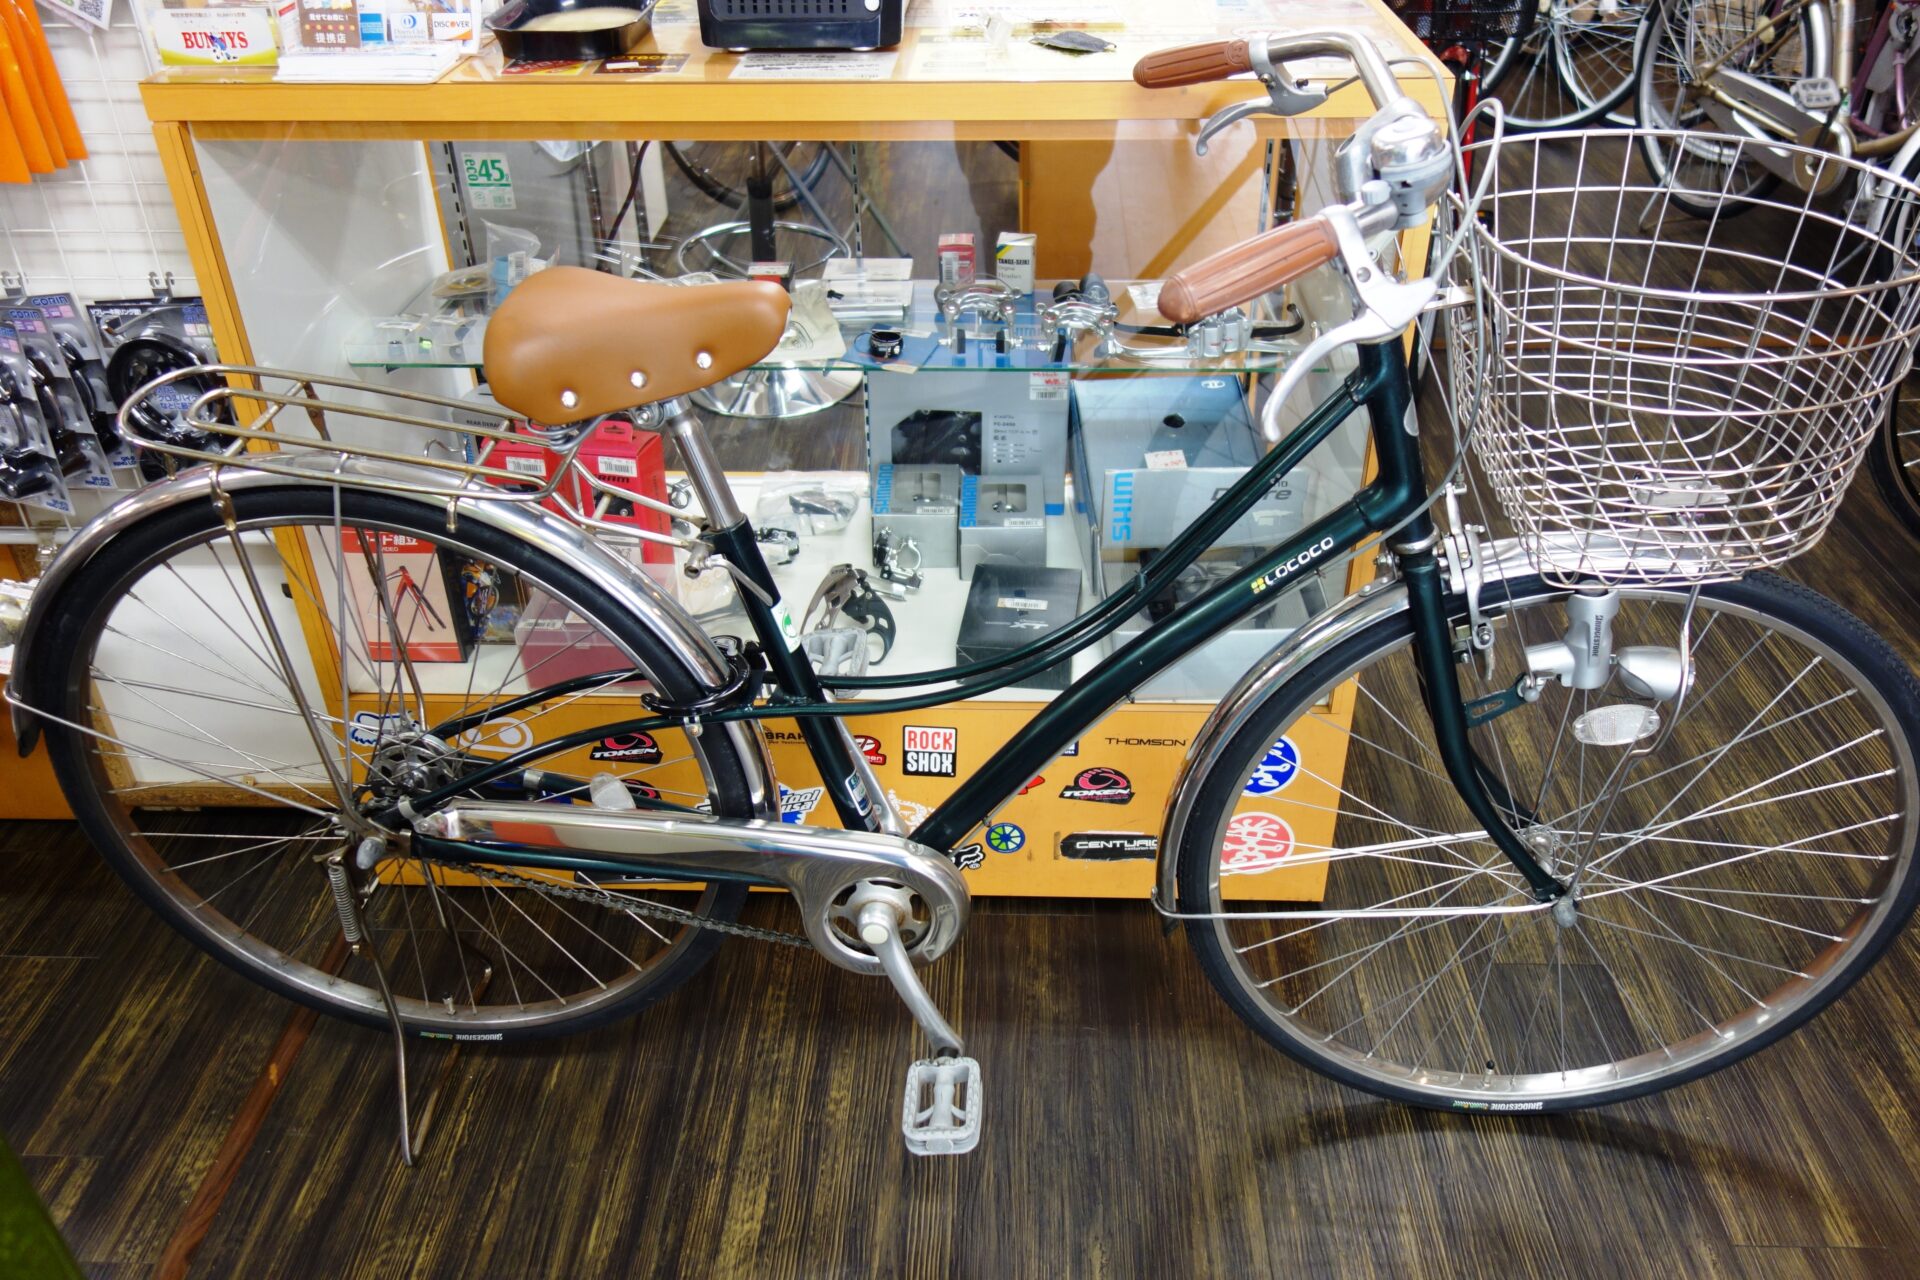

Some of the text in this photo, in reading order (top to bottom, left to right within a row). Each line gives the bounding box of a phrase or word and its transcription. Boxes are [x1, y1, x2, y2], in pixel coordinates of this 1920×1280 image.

[433, 20, 470, 29] DISCOVER
[314, 32, 348, 44] 提携店
[464, 158, 479, 182] eco
[874, 464, 893, 514] SHIMANO
[1210, 487, 1293, 501] Dre
[1111, 472, 1134, 542] SHIM
[1264, 535, 1335, 586] LOCOCO
[1592, 615, 1604, 657] BRIDGESTONE
[907, 729, 953, 751] ROCK
[1104, 737, 1188, 747] THOMSON
[592, 746, 658, 759] TOKEN
[906, 752, 953, 774] SHOX
[781, 788, 819, 803] Tool
[1063, 788, 1130, 797] TOKEN
[780, 800, 814, 812] usa
